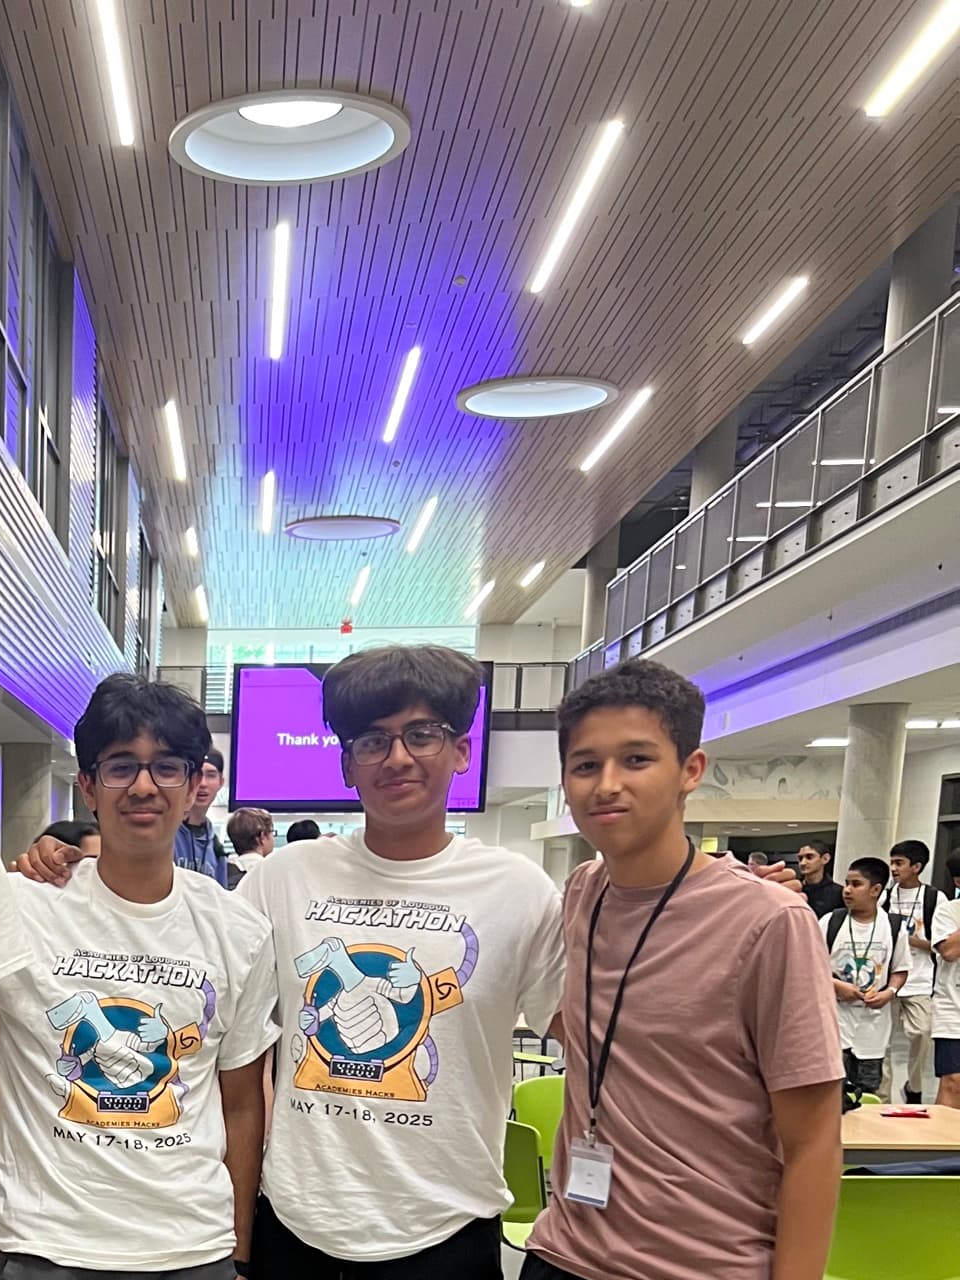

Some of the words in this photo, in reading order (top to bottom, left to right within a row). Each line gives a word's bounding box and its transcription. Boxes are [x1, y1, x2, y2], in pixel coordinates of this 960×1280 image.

[276, 732, 319, 747] Thank
[322, 735, 339, 748] yo
[326, 896, 384, 907] ACADEMIES
[400, 899, 450, 912] LOUDOUN
[305, 900, 467, 932] HACKATHON
[73, 948, 129, 962] ACADEMIES
[130, 954, 145, 963] OF
[52, 955, 207, 990] HACKATHON
[336, 1063, 376, 1078] 4000
[314, 1083, 363, 1095] ACADEMIES
[365, 1089, 395, 1098] HACKS
[104, 1098, 143, 1110] 4000
[324, 1103, 376, 1124] 17-18,
[384, 1112, 433, 1126] 2025
[53, 1126, 87, 1143] MAY
[95, 1135, 149, 1150] 17-18,
[154, 1132, 192, 1149] 2025
